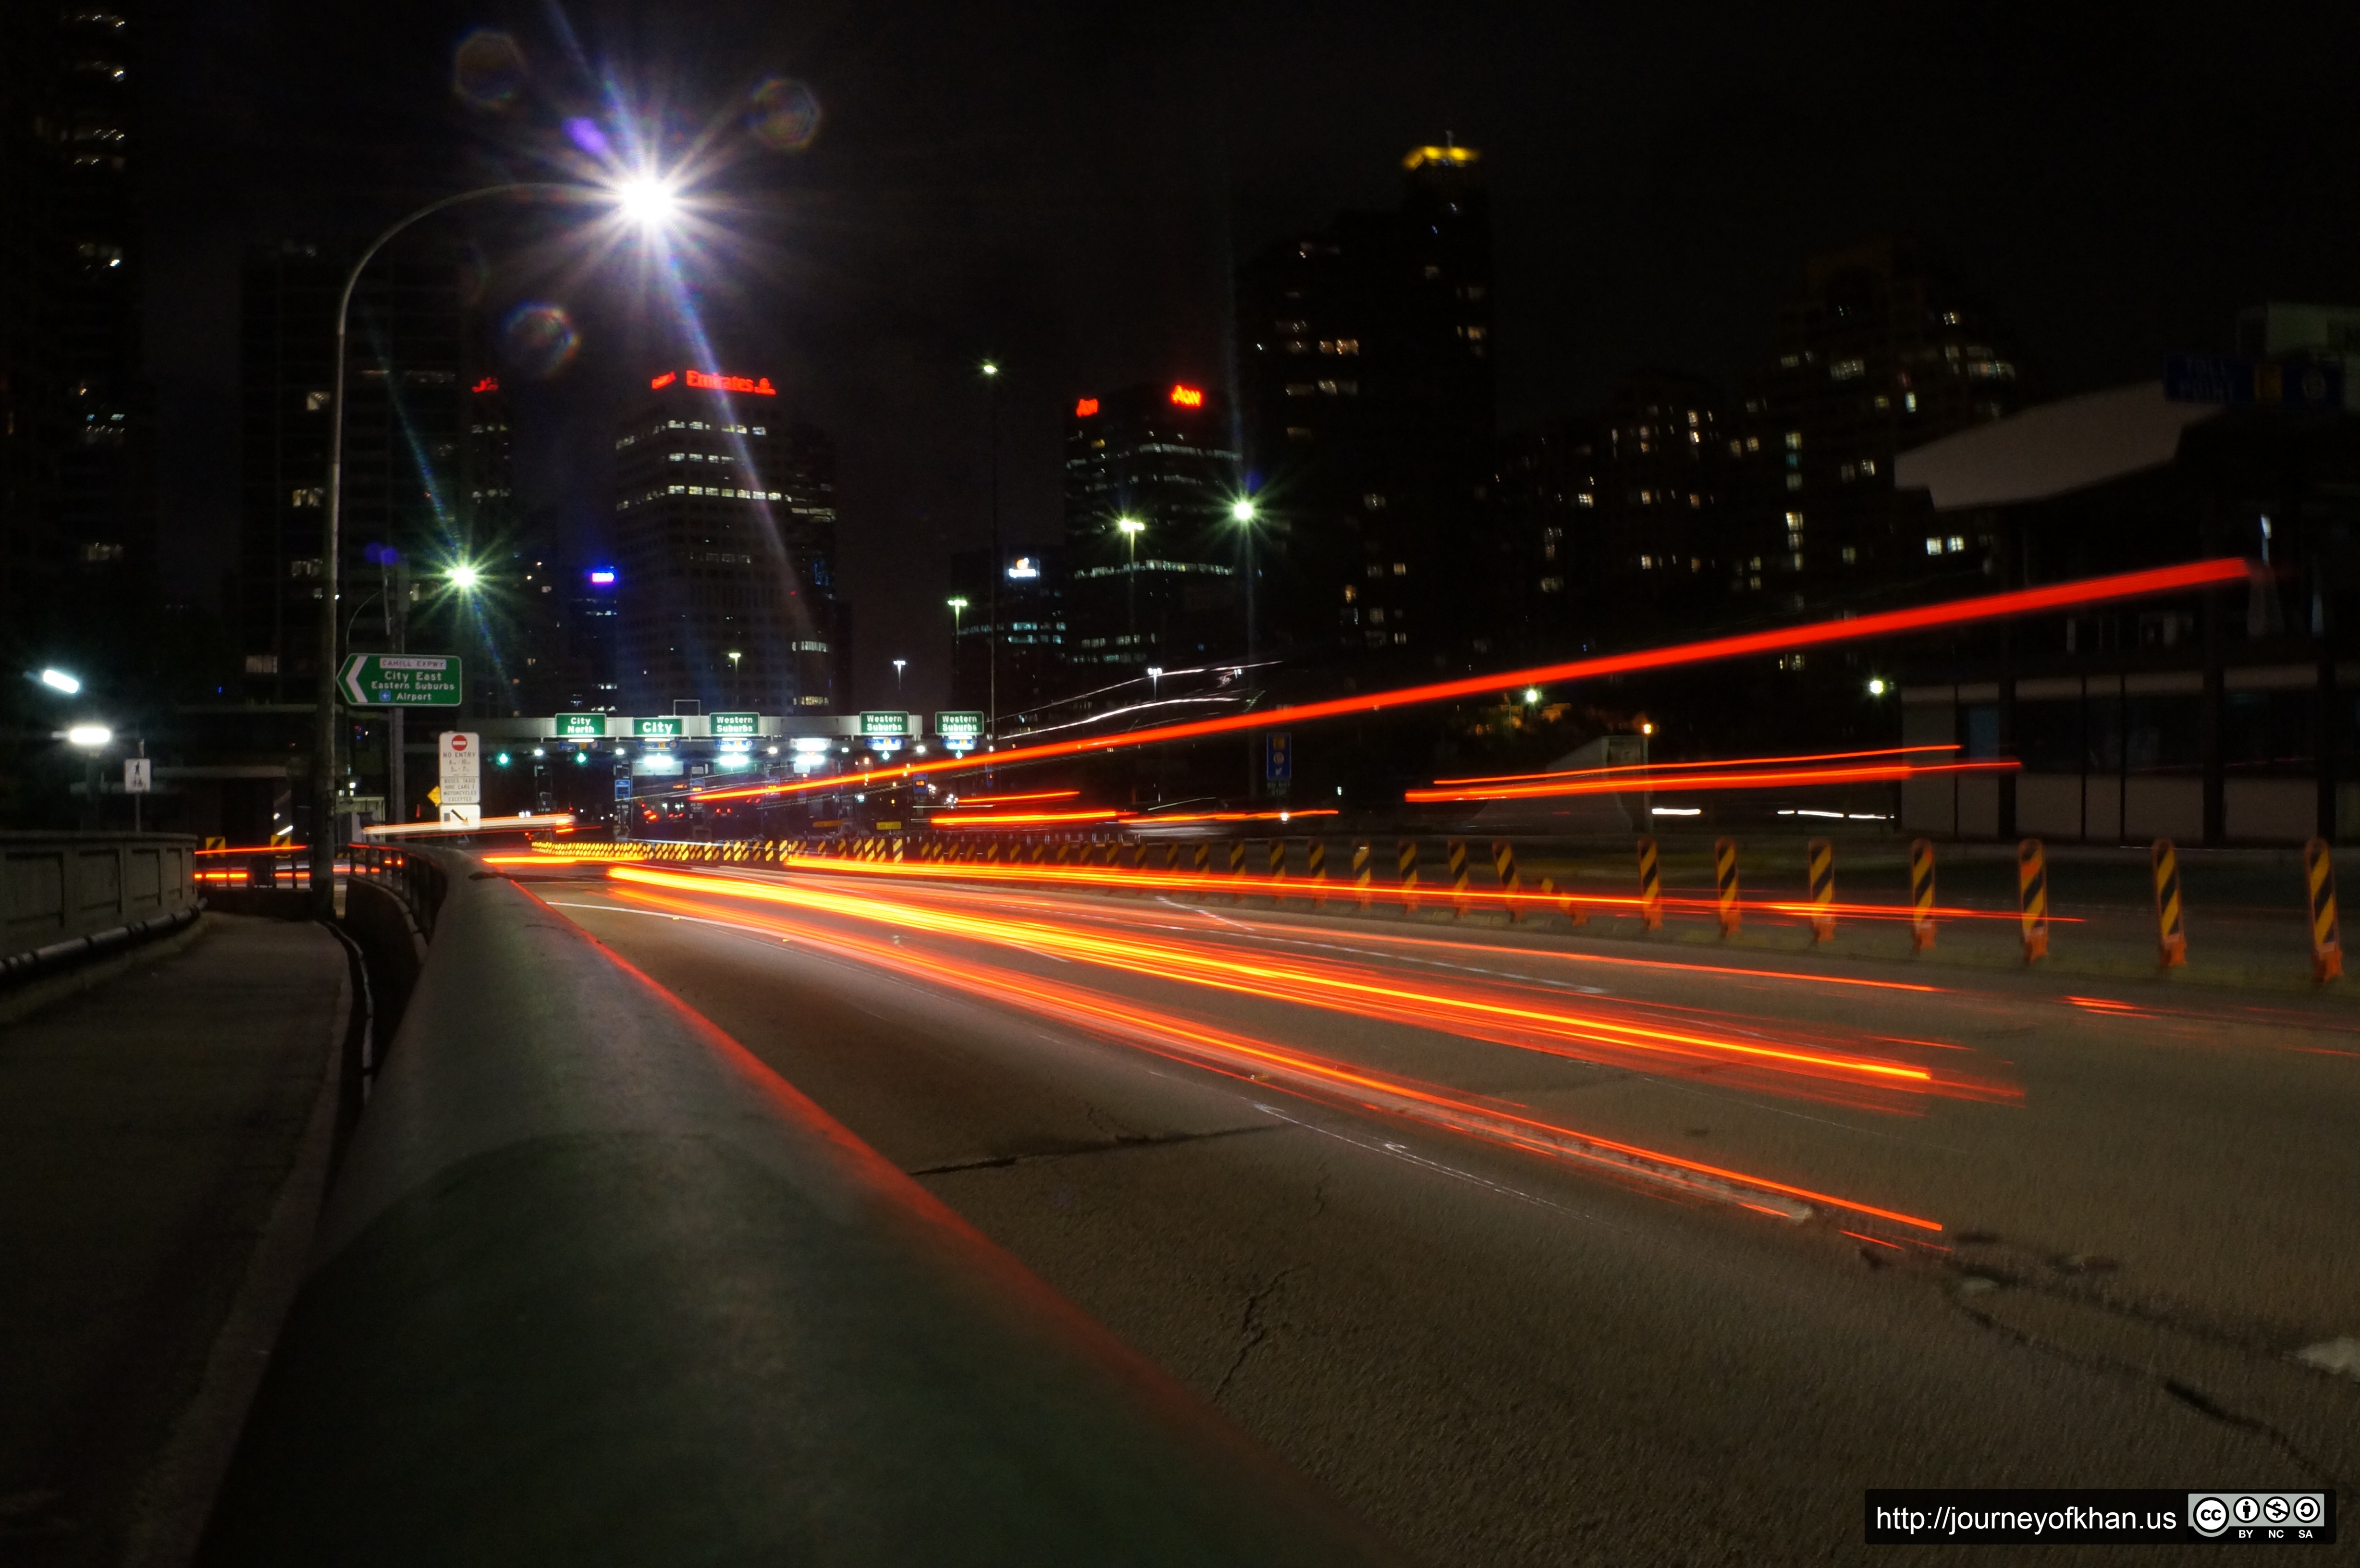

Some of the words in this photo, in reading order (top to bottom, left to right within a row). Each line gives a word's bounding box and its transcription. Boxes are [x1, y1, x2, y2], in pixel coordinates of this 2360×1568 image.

[384, 671, 409, 682] City
[416, 671, 442, 680] East
[371, 681, 410, 689] Eastern
[415, 682, 455, 690] Suburbs
[396, 692, 432, 701] Airport
[942, 715, 978, 723] Western
[567, 725, 594, 734] North
[643, 722, 673, 735] City
[867, 723, 902, 732] Suburbs
[943, 724, 977, 732] Suburbs
